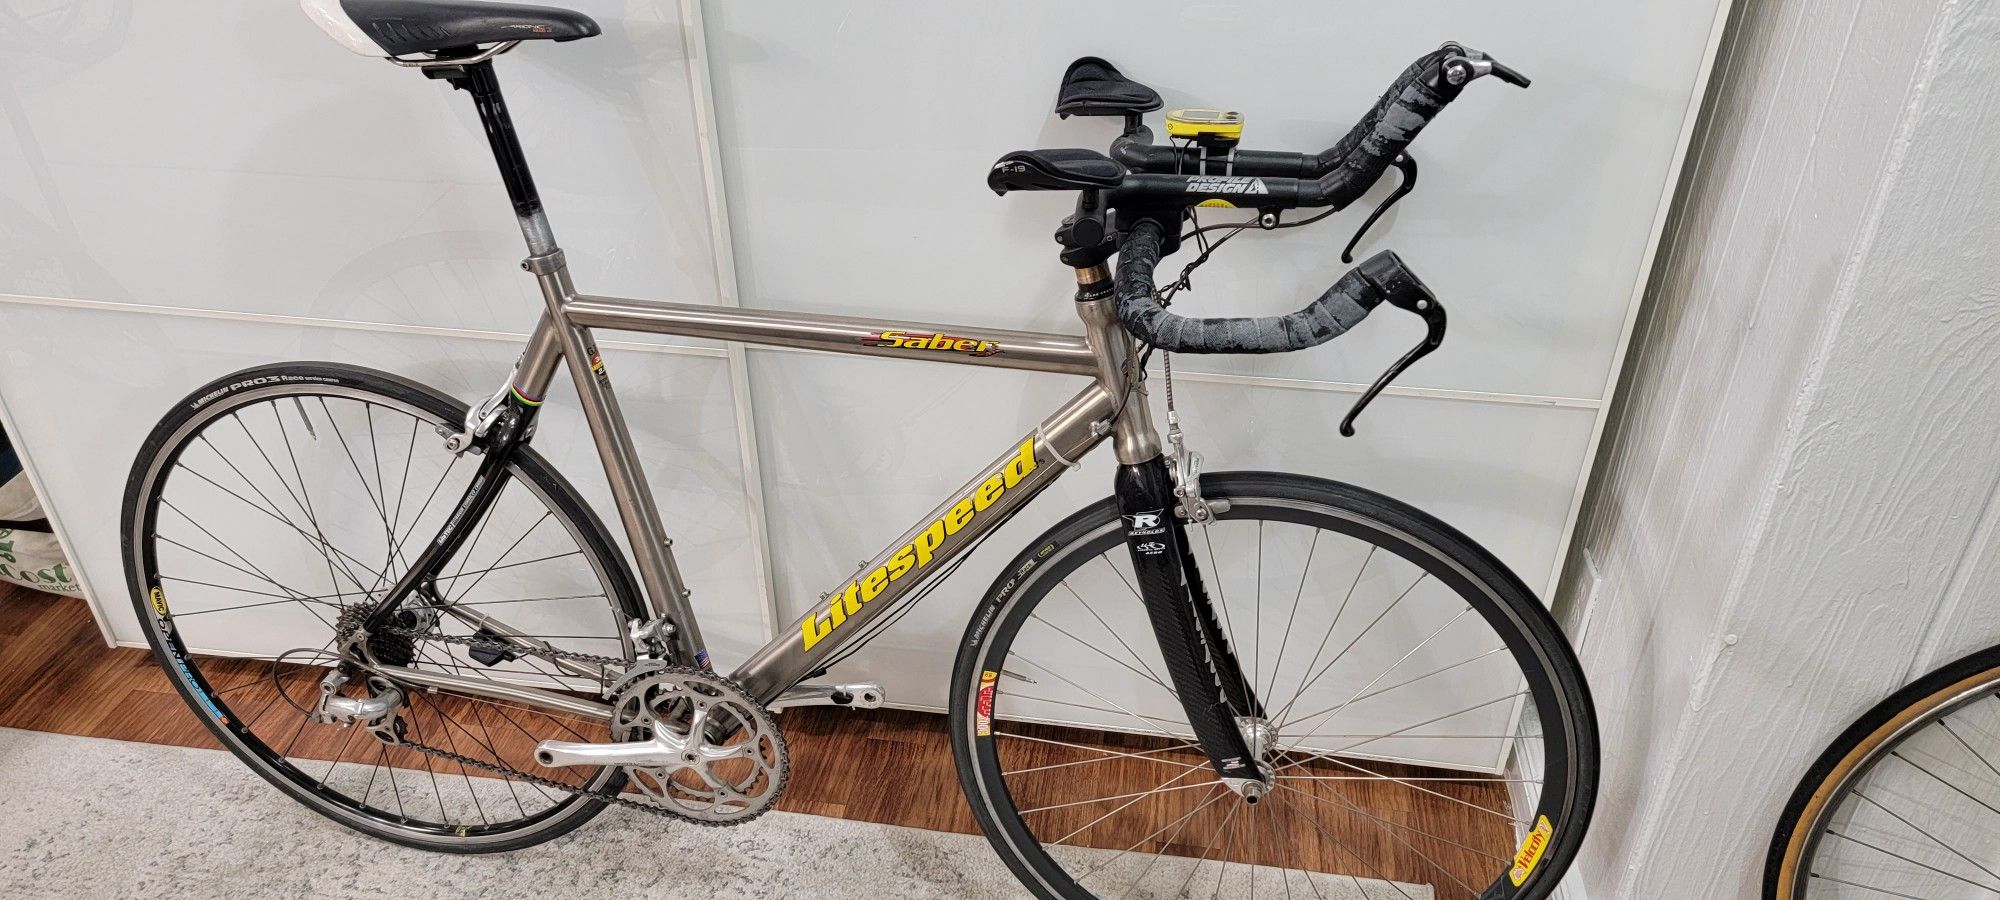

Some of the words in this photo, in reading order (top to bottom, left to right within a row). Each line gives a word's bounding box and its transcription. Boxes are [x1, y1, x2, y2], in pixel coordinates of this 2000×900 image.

[1002, 165, 1026, 173] F-19
[1186, 175, 1253, 184] PROFILE
[1185, 183, 1248, 194] DESIGN
[877, 330, 1001, 352] Saber
[197, 386, 229, 405] MICHELIN
[230, 375, 281, 391] PRO3
[801, 434, 1039, 653] Litespeed
[38, 582, 81, 592] market
[153, 590, 166, 613] MAVIC
[973, 604, 996, 640] MICHELIN
[1517, 830, 1546, 869] Velocity
